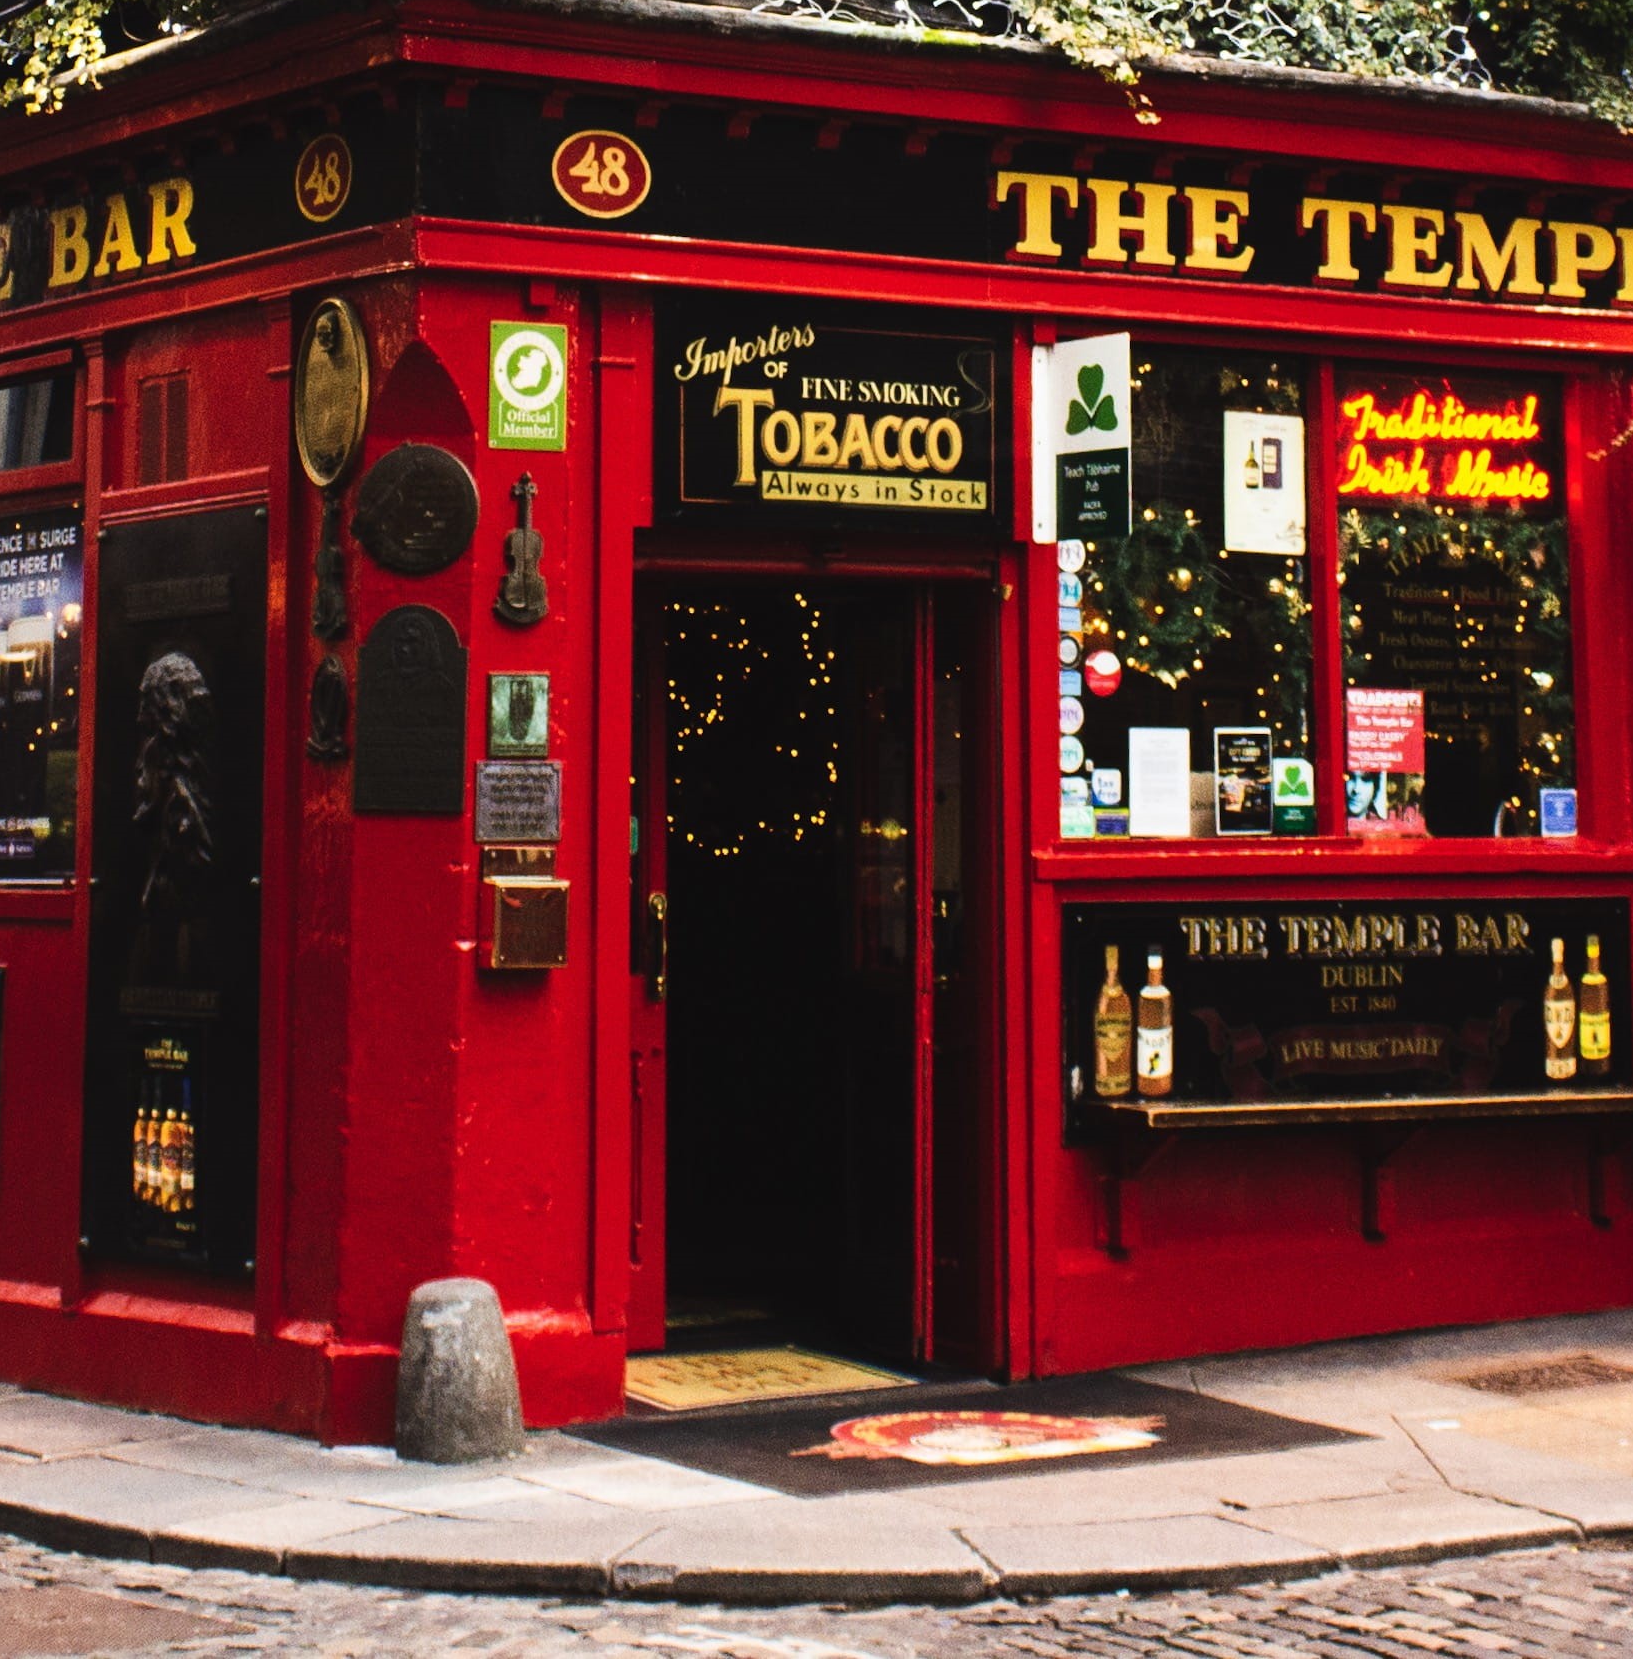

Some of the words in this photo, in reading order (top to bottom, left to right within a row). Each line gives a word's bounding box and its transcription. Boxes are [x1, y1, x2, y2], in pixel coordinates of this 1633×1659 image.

[304, 145, 343, 208] 48
[568, 142, 631, 197] 48
[48, 176, 197, 291] BAR
[991, 171, 1257, 277] THE
[674, 323, 816, 385] Importers
[763, 360, 788, 379] OF
[801, 377, 853, 401] FINE
[858, 382, 961, 407] SMOKING
[503, 422, 556, 439] Member
[507, 409, 551, 424] Official
[1343, 393, 1539, 440] Traditional
[1338, 444, 1431, 494] Irish
[1446, 449, 1549, 499] Music
[766, 471, 860, 500] Always
[875, 475, 898, 501] in
[908, 477, 983, 505] Stock
[40, 527, 77, 550] SURGE
[19, 555, 48, 575] HERE
[50, 553, 64, 573] AT
[37, 578, 61, 598] BAR
[1180, 916, 1269, 959] THE
[1279, 914, 1443, 957] TEMPLE
[1455, 913, 1535, 956] BAR
[1322, 965, 1404, 988] DUBLIN
[1281, 1040, 1325, 1063] LIVE
[1330, 1041, 1380, 1060] MUSIC
[1390, 1037, 1445, 1057] DAILY
